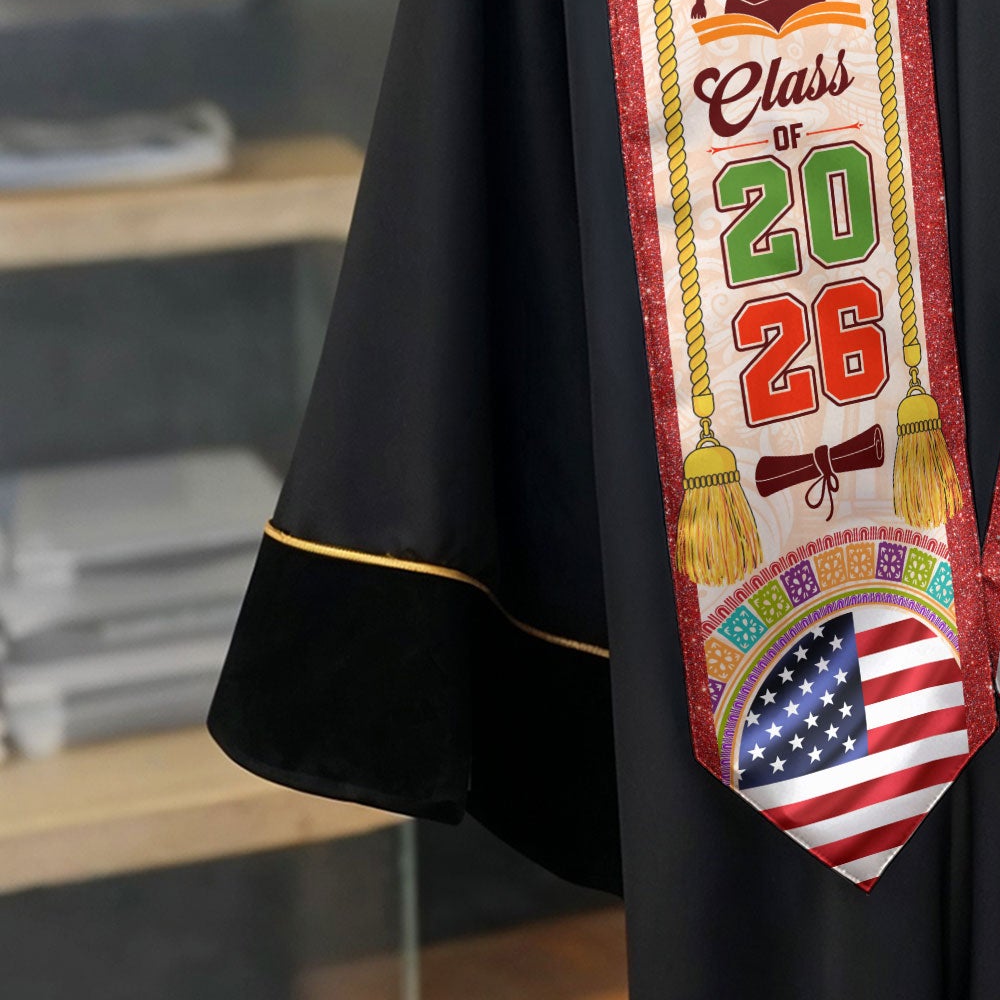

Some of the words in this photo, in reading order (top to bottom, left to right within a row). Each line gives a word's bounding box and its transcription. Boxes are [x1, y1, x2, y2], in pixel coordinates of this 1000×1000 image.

[693, 48, 856, 138] Class
[773, 122, 804, 151] OF
[713, 140, 880, 290] 20
[731, 276, 890, 429] 26
